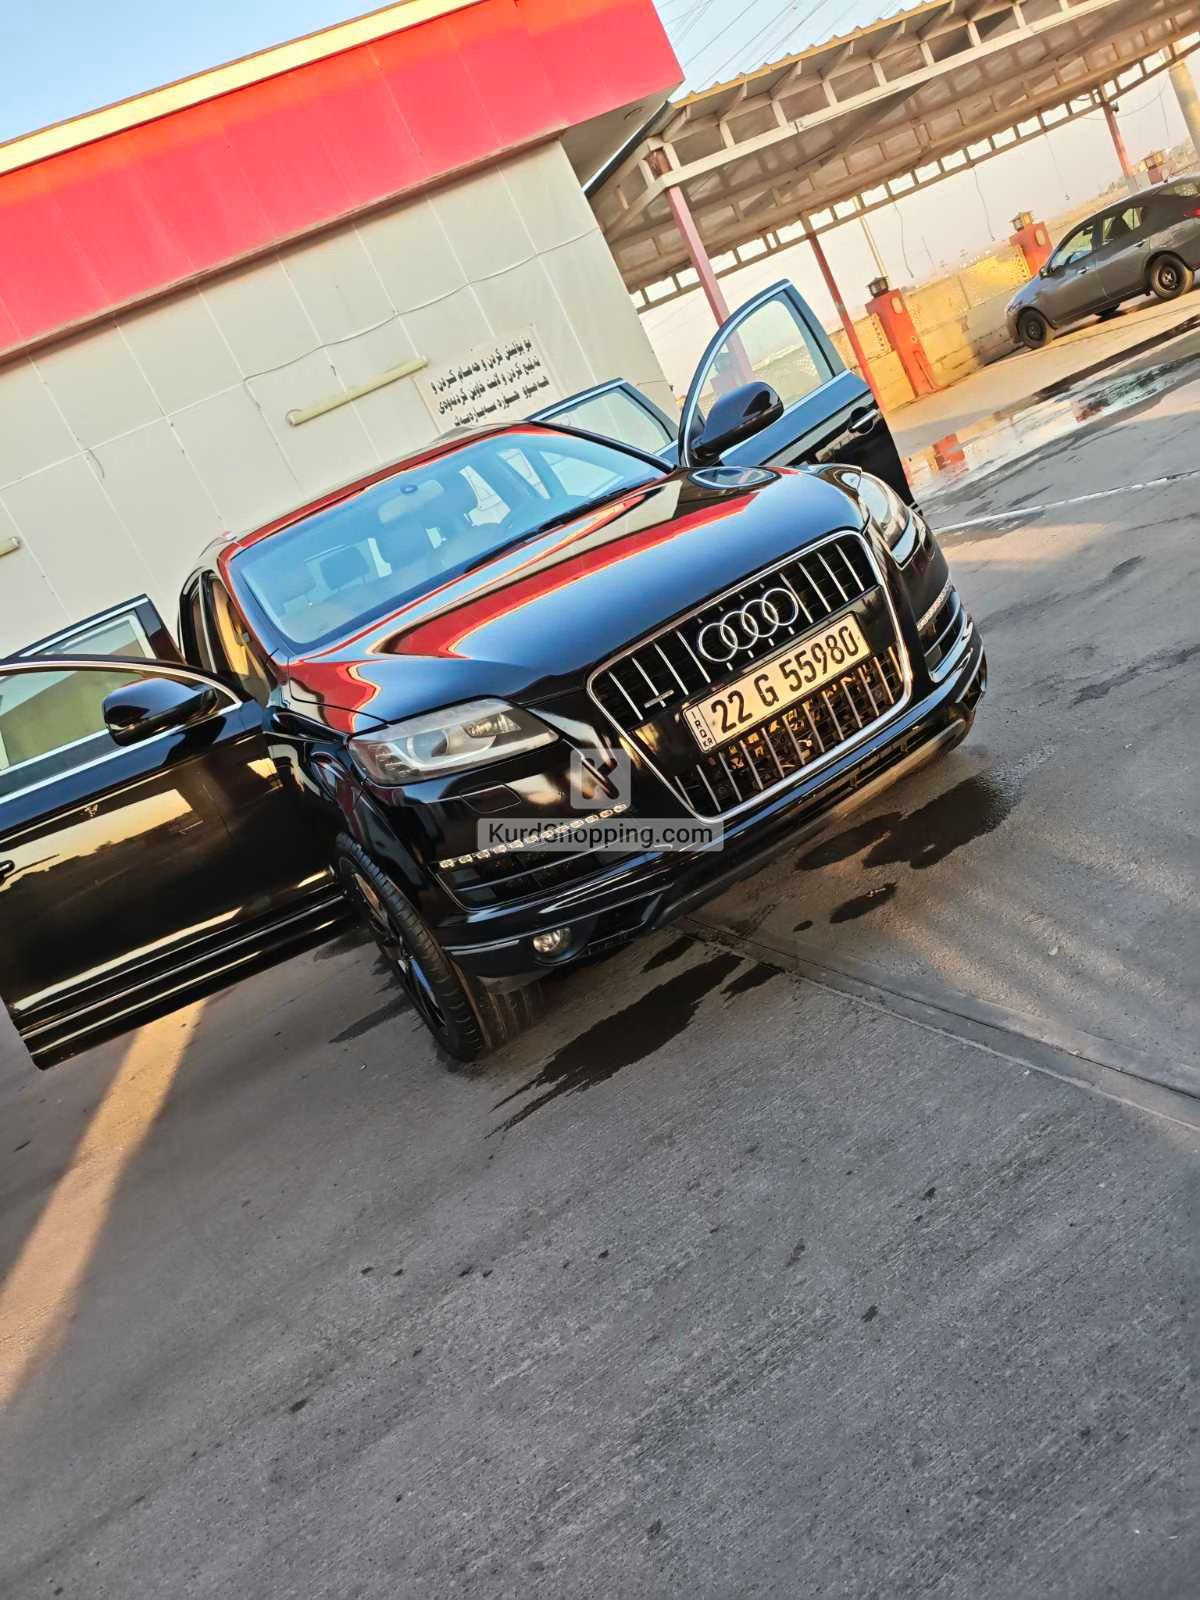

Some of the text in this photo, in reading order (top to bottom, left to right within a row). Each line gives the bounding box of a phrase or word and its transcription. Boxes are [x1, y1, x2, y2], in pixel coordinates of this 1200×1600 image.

[711, 625, 859, 734] 22 G 55980
